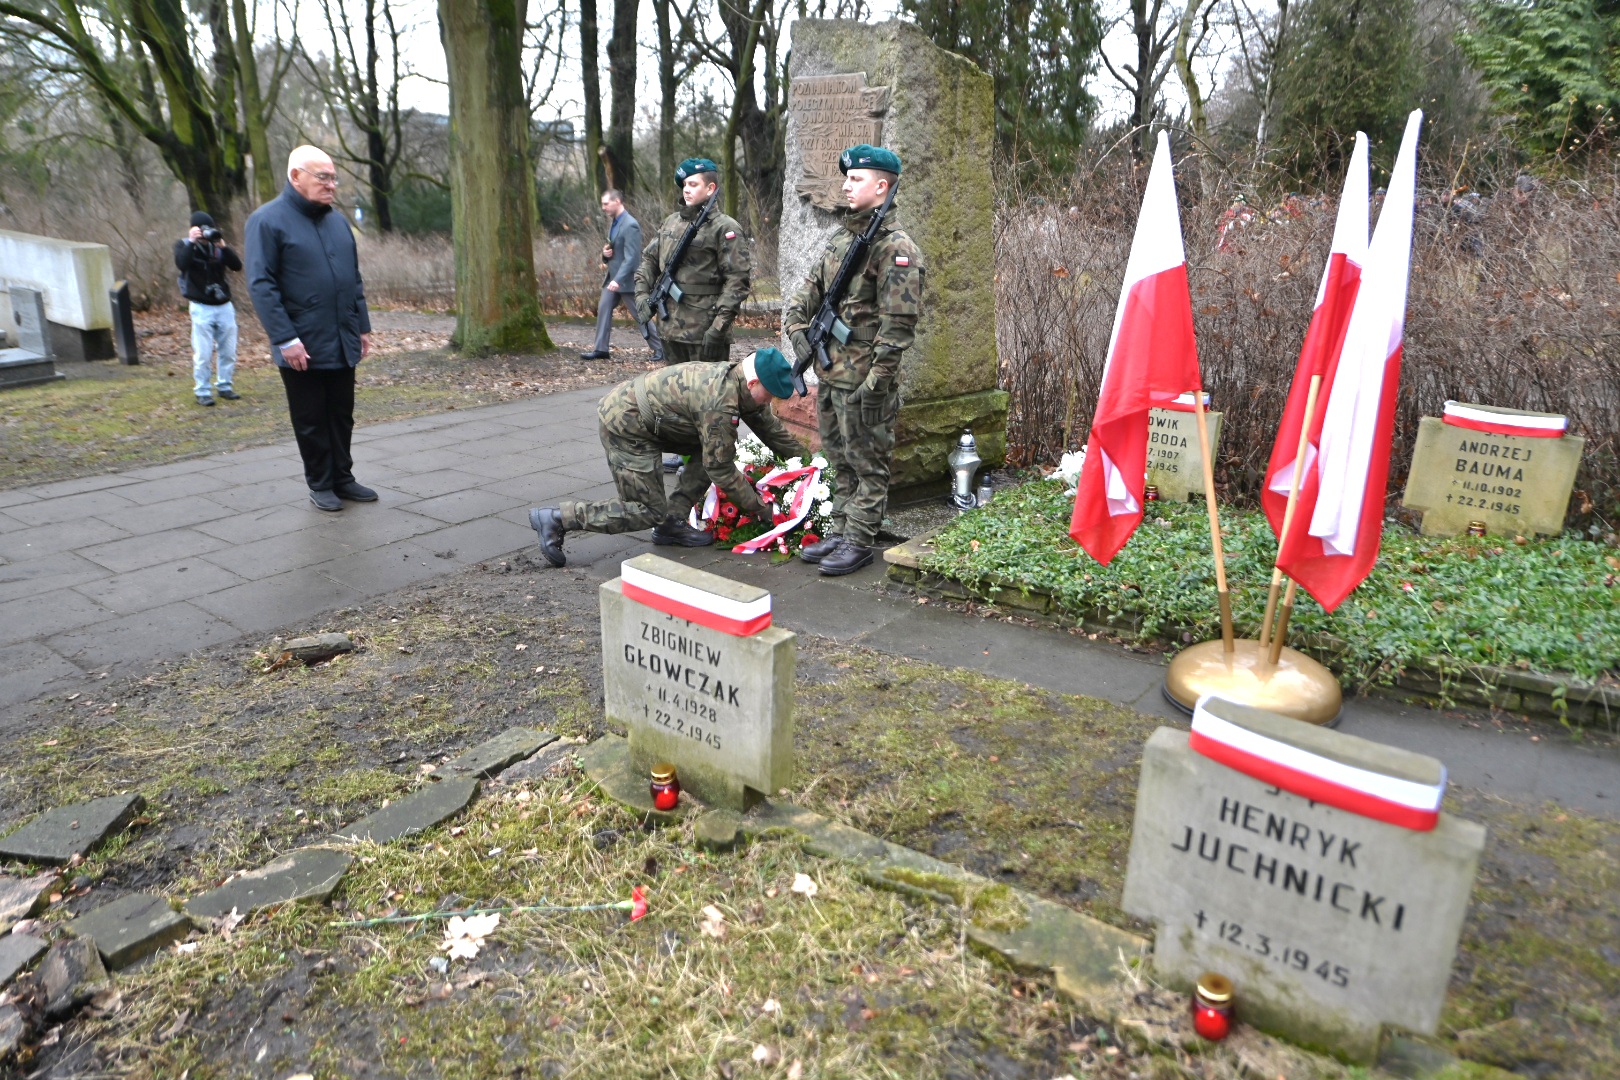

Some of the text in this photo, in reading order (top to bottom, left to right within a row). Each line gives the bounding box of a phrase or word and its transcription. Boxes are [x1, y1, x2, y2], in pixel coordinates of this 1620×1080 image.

[844, 96, 874, 110] WALCE
[802, 112, 809, 124] O
[838, 123, 871, 137] MIASTA
[799, 138, 819, 150] PRZY
[820, 138, 843, 150] BOKU
[1148, 432, 1187, 448] BODA
[1148, 448, 1179, 460] 7.1907
[1459, 440, 1532, 462] ANDRZEJ
[1146, 461, 1178, 473] 2.1945
[1455, 458, 1523, 482] BAUMA
[1462, 481, 1522, 498] 11.10.1902
[1457, 495, 1521, 515] 22.2.1945
[640, 621, 721, 668] ZBIGNIEW
[624, 643, 740, 708] GŁOWCZAK
[658, 687, 717, 723] 11.4.1928
[655, 709, 722, 750] 22.2.1945
[1218, 797, 1364, 869] HENRYK
[1171, 826, 1405, 932] JUCHNICKI
[1218, 920, 1351, 989] 12.3.1945
